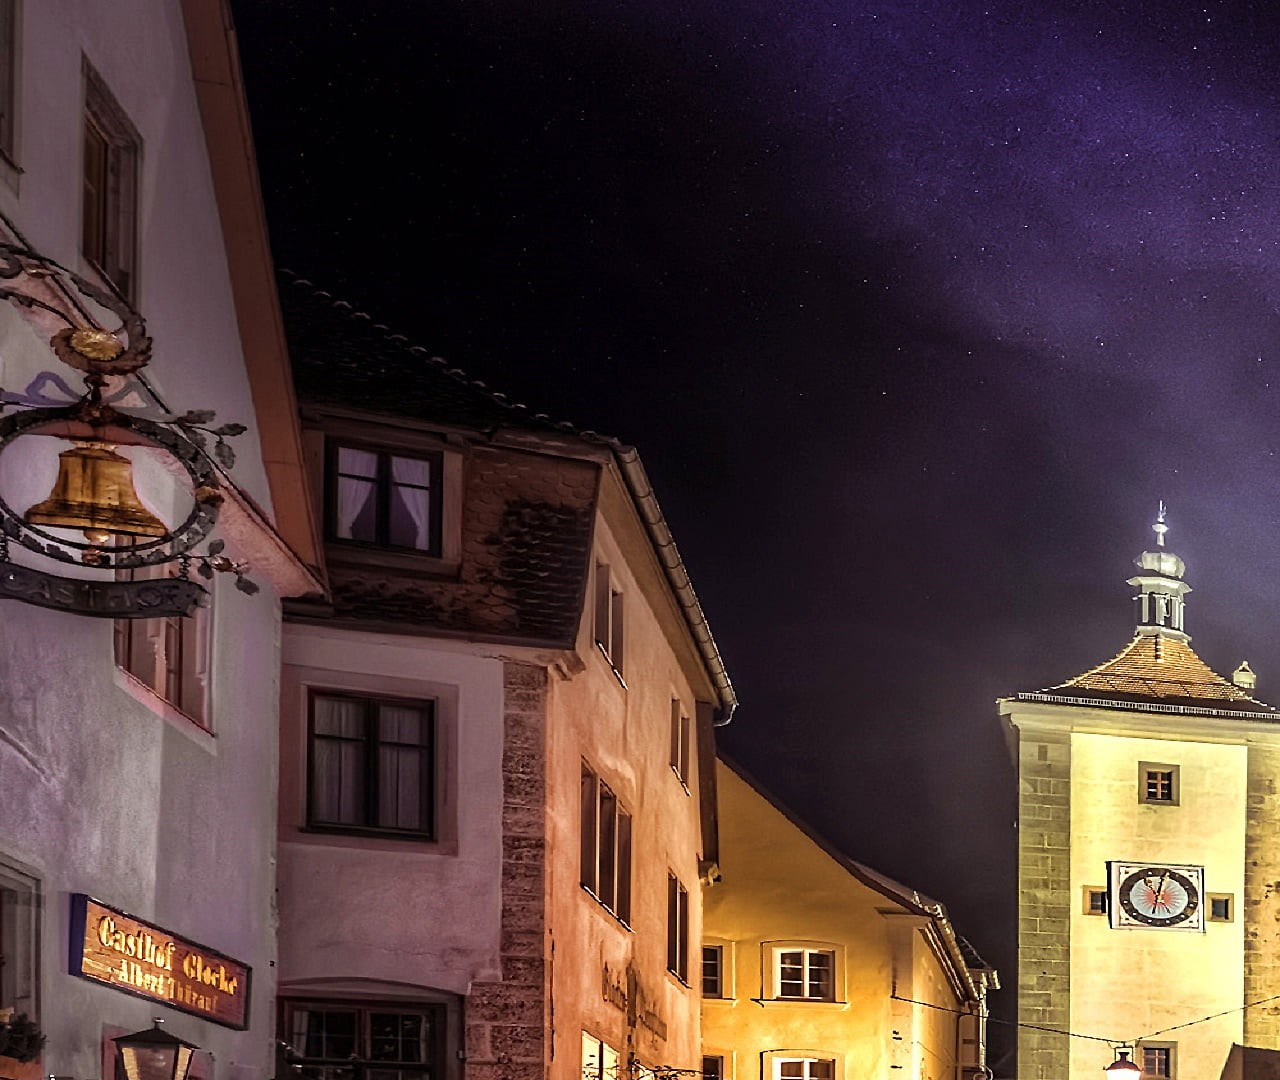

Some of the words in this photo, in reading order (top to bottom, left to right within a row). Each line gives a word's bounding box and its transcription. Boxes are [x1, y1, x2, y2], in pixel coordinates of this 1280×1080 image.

[98, 915, 176, 971] Gasthof
[183, 952, 238, 996] Glocke
[116, 959, 165, 995] Albert
